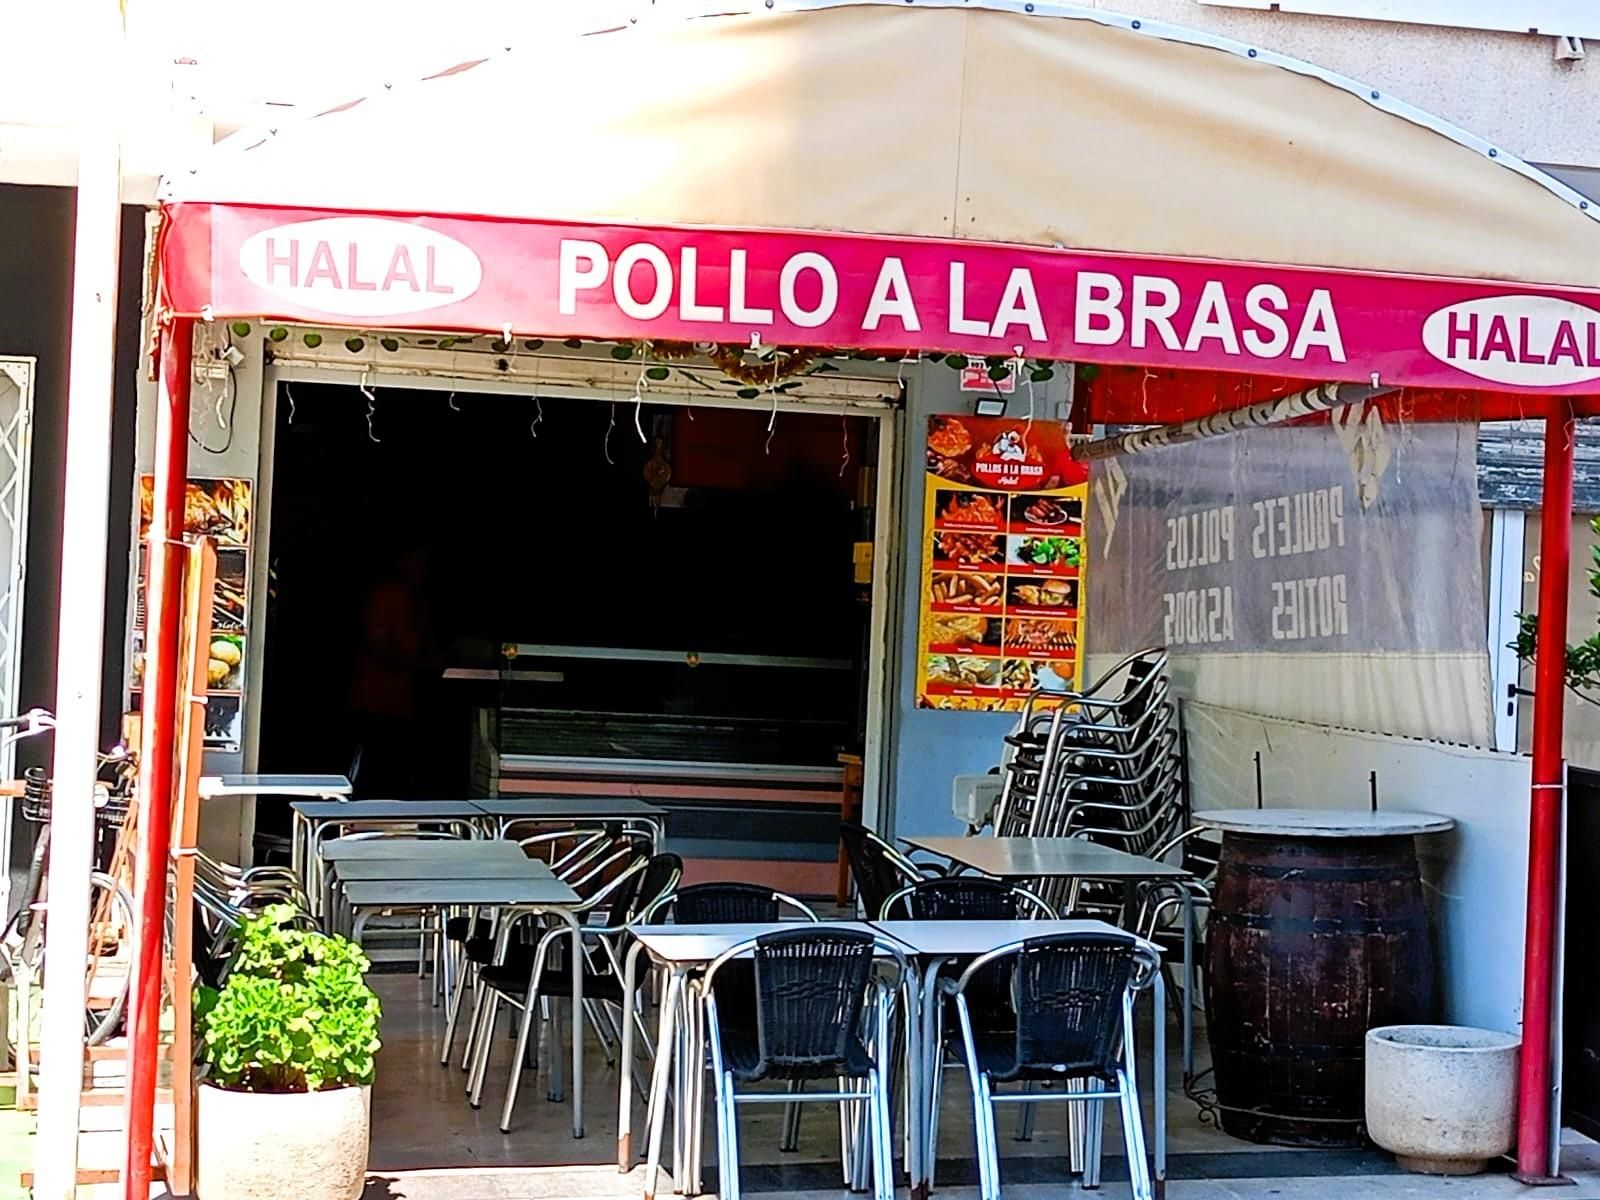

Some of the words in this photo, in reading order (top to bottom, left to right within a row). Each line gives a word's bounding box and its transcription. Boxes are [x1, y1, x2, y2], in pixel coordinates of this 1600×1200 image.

[265, 237, 454, 294] HALAL
[558, 239, 838, 328] POLLO
[861, 257, 921, 332] A
[947, 261, 1048, 342] LA
[1073, 270, 1348, 364] BRASA
[1447, 312, 1600, 367] HALAL
[976, 462, 1002, 474] POLLOS
[1003, 463, 1009, 474] A
[1010, 464, 1019, 475] LA
